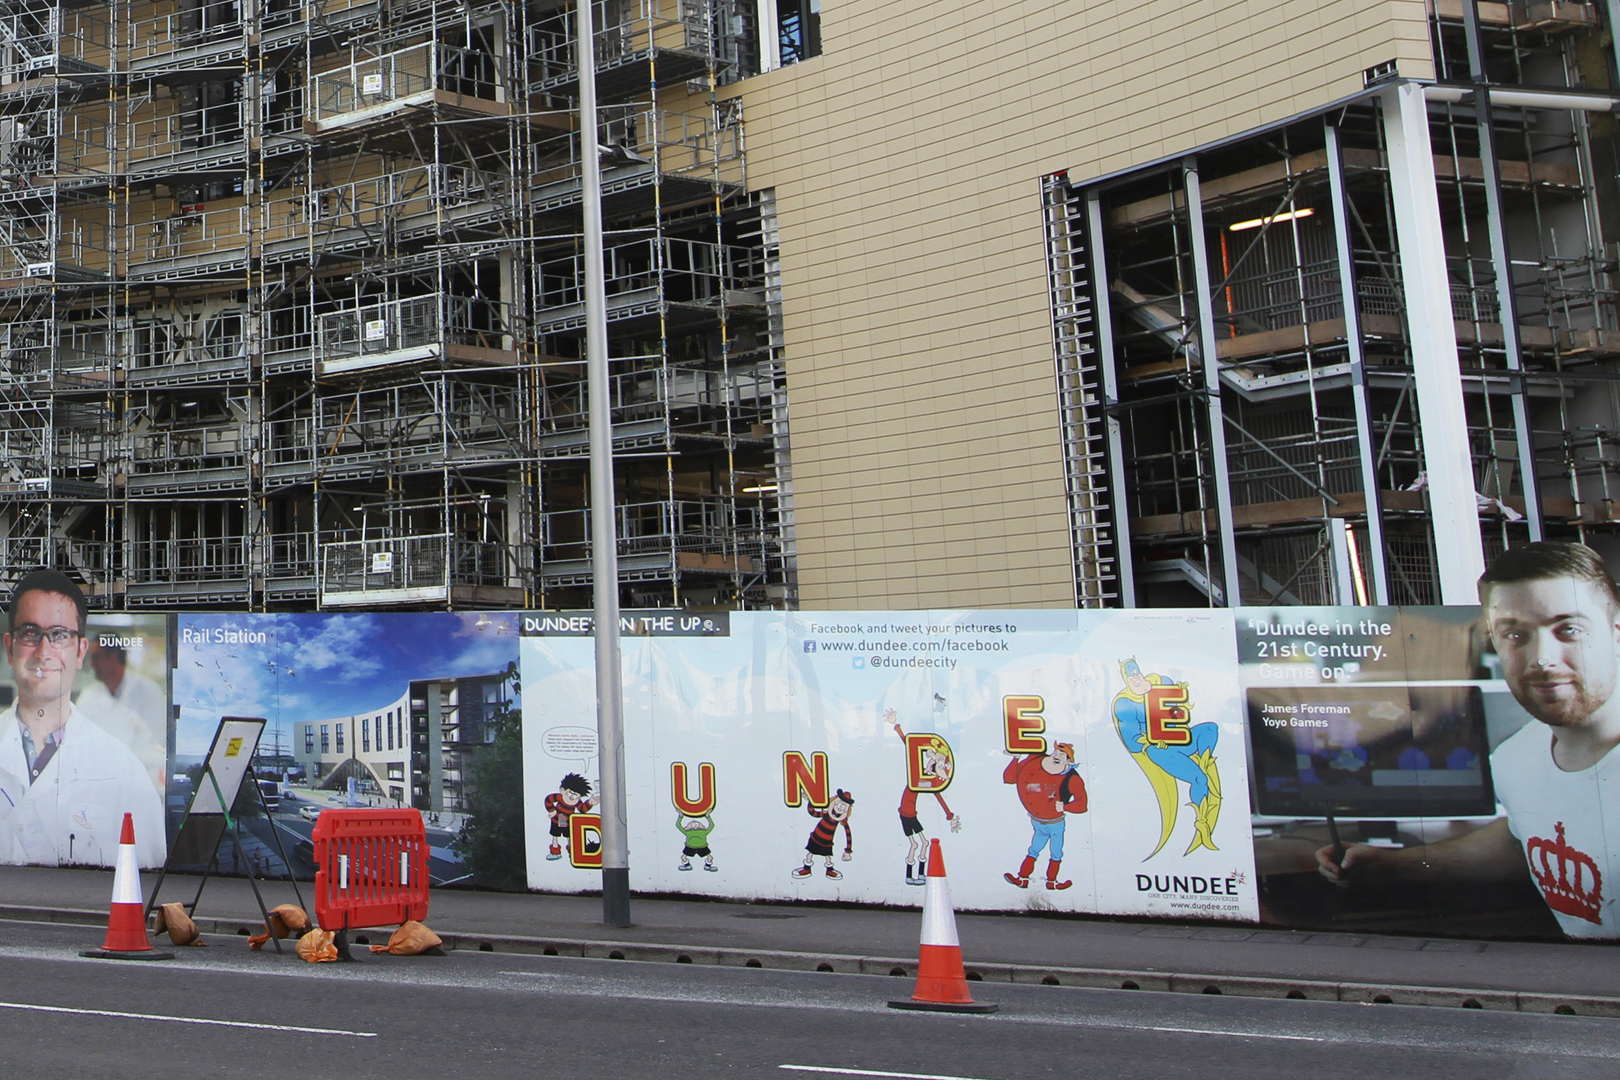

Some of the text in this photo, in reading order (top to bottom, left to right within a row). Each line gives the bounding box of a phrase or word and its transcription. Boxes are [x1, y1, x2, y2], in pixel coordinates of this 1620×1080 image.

[619, 617, 635, 632] N
[642, 617, 675, 631] THE
[810, 623, 1017, 636] Facebook and tweet your pictures to
[1336, 619, 1354, 636] in
[1359, 619, 1392, 636] the
[99, 637, 143, 648] DUNDEE
[183, 628, 266, 644] Rail Station
[821, 638, 1010, 652] www.dundee.com/facebook
[1257, 641, 1387, 662] 21st Century.
[870, 656, 958, 670] @dundeecity
[1260, 663, 1315, 679] Game
[1262, 703, 1350, 714] James Foreman
[1262, 717, 1329, 729] Yoyo Games
[670, 761, 716, 818] U
[782, 750, 829, 808] N
[1002, 694, 1047, 754] E
[1144, 684, 1192, 746] E
[1135, 873, 1239, 896] DUNDEE
[1170, 902, 1240, 911] www.dundee.com
